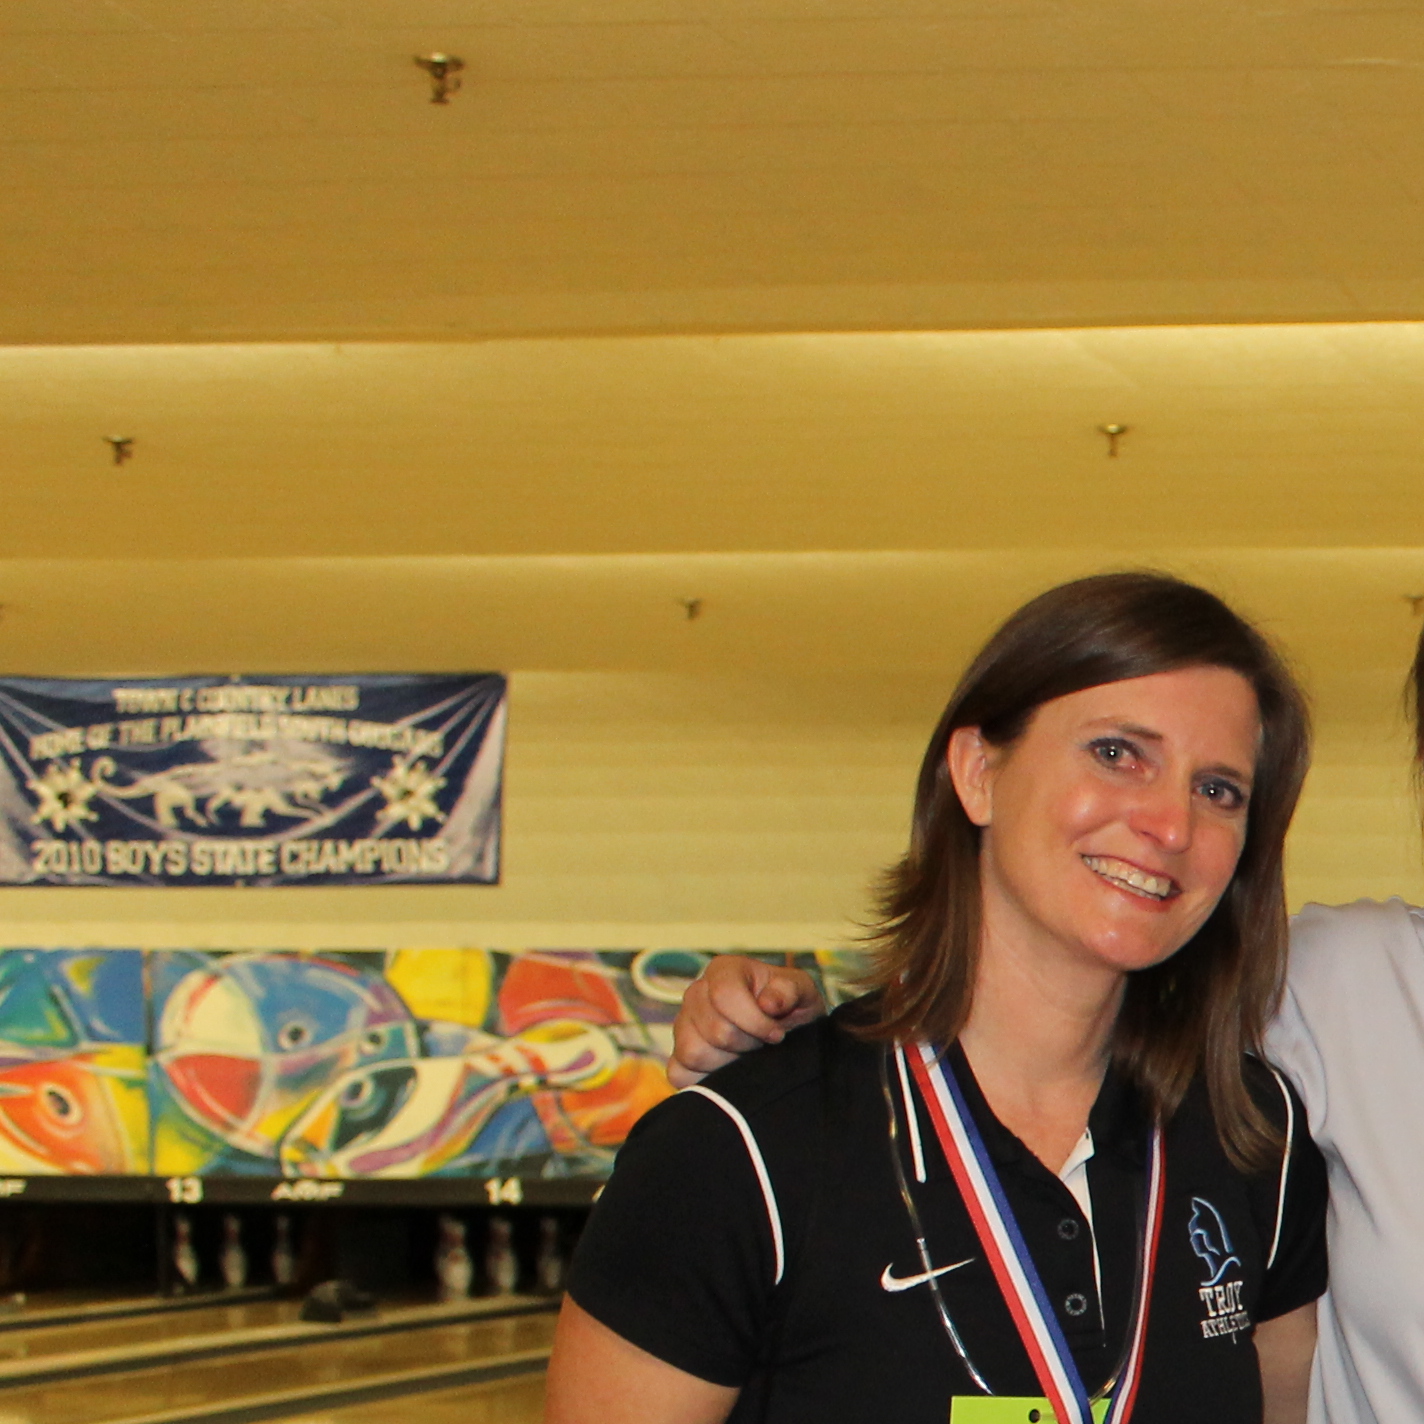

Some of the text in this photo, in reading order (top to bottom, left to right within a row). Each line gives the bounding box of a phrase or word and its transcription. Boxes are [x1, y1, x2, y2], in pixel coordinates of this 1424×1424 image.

[31, 837, 450, 876] 2010 BOYS STATE CHAMPIONS
[166, 1176, 203, 1203] 13
[484, 1177, 522, 1206] 14
[1199, 1281, 1243, 1317] TROY
